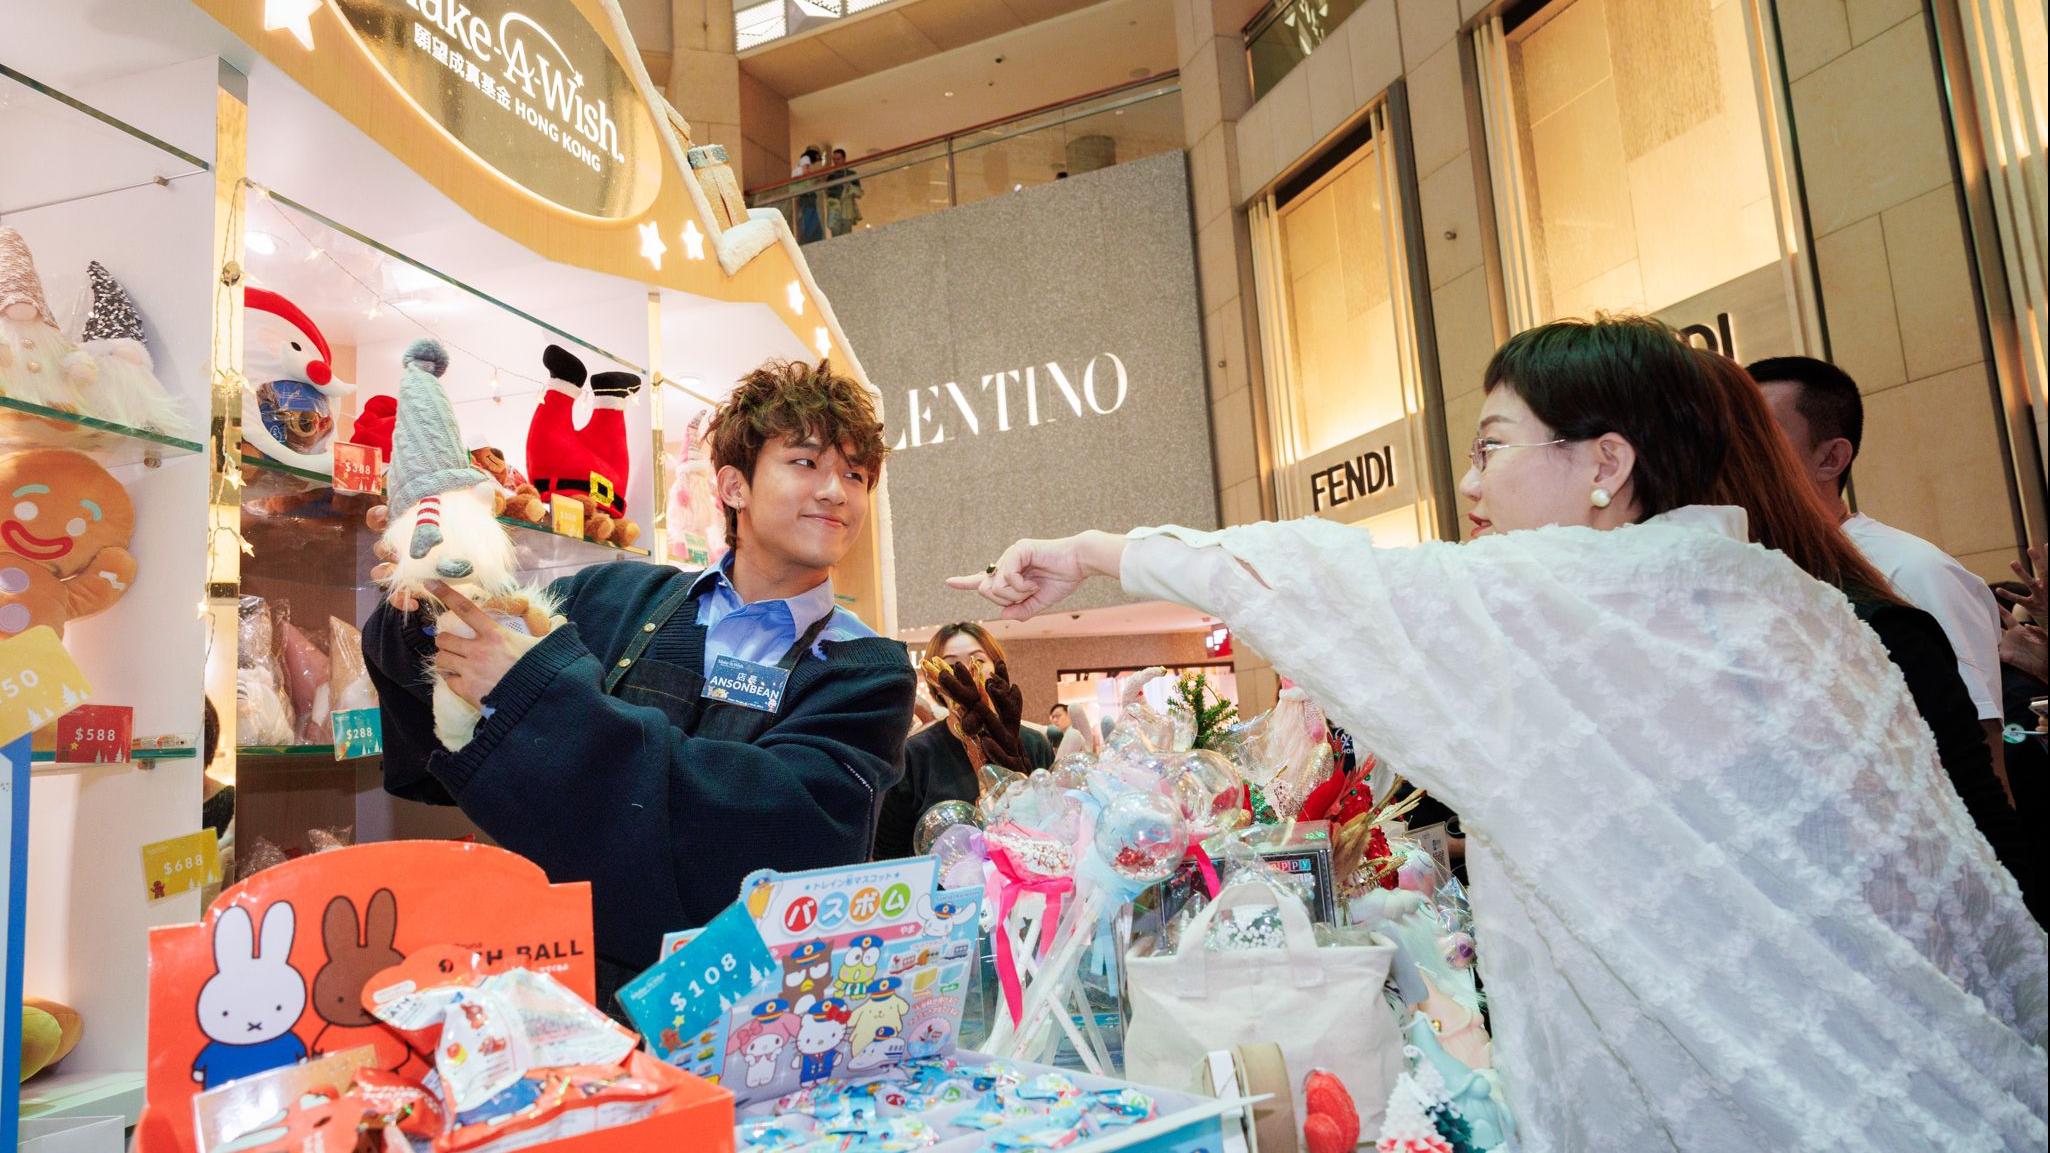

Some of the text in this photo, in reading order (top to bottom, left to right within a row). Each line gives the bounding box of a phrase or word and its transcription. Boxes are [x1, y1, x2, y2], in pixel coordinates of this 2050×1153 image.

[414, 22, 511, 111] 願望成真基金
[515, 97, 601, 172] HONG KONG
[1311, 445, 1394, 513] FENDI
[709, 675, 780, 700] ANSONBEAN
[75, 727, 116, 742] $588
[346, 727, 373, 741] $288
[163, 853, 204, 876] $688
[670, 952, 737, 1012] $108
